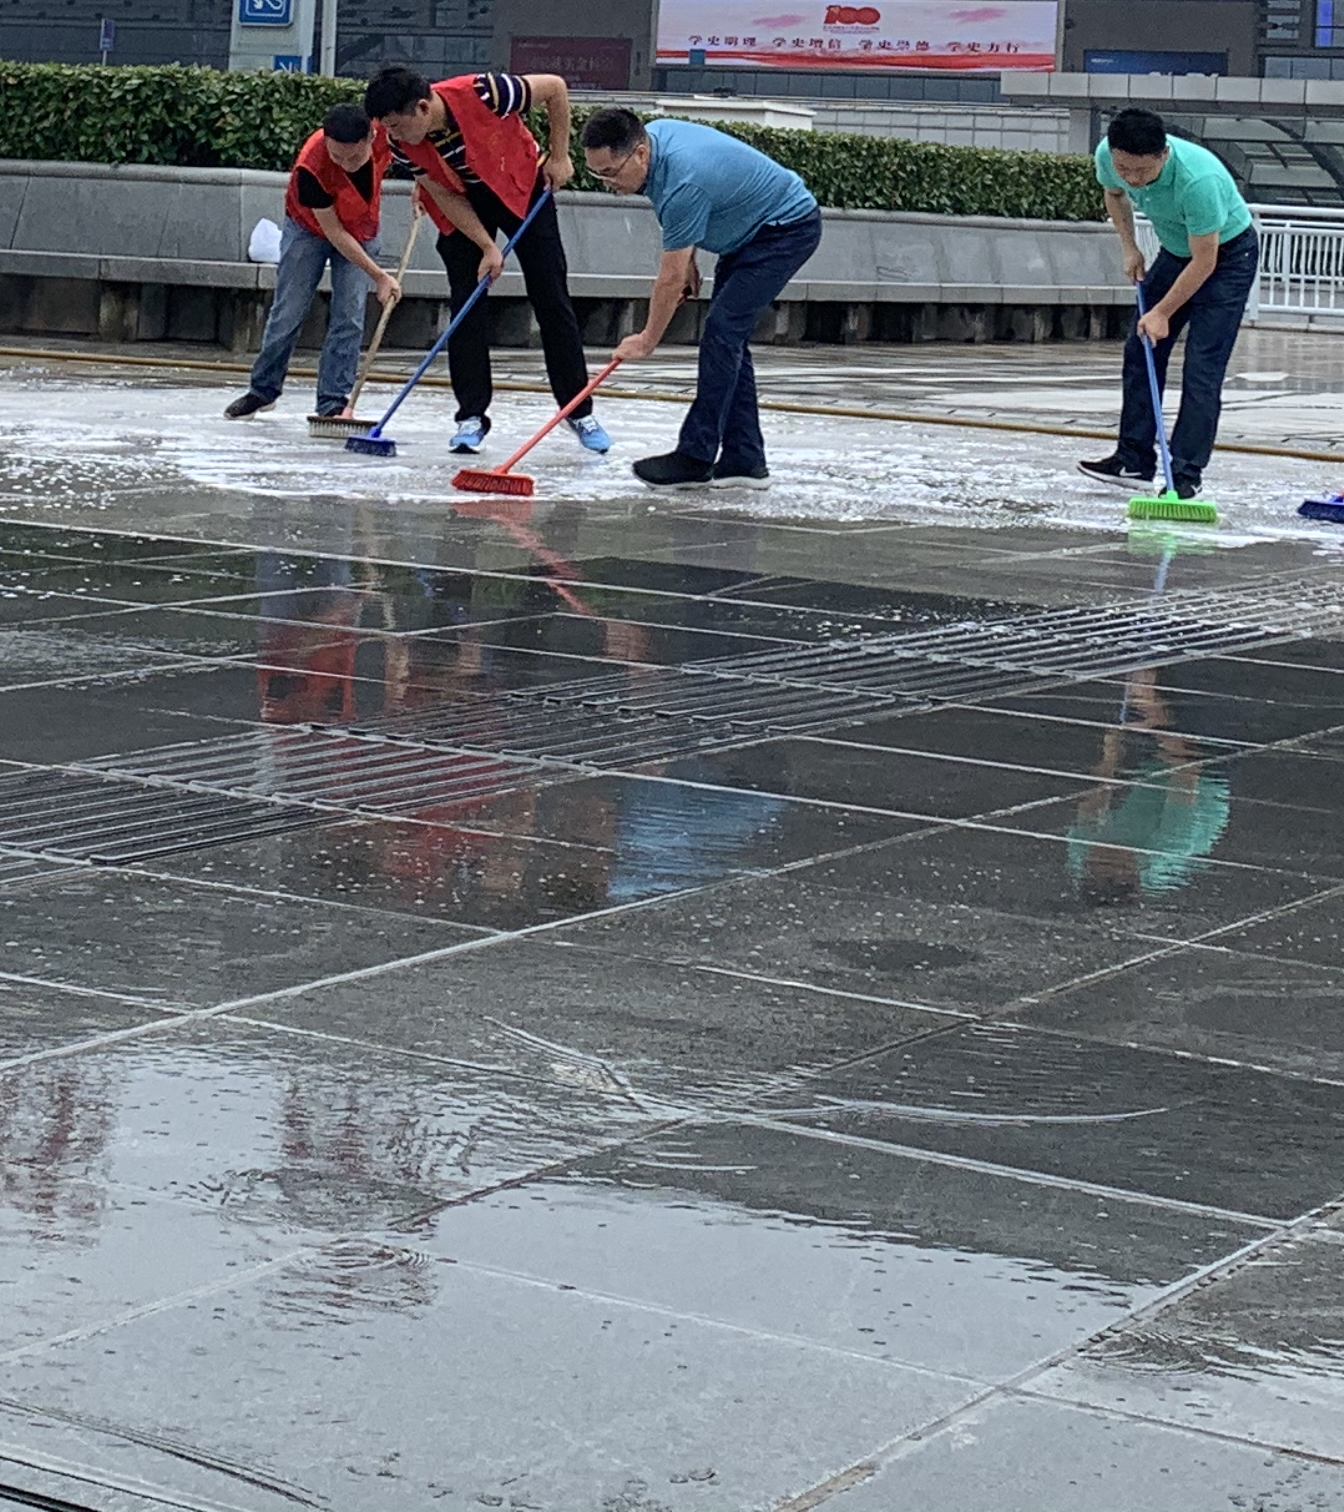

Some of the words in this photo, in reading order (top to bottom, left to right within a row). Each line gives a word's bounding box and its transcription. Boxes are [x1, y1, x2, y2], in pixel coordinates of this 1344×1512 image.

[824, 5, 881, 25] 100
[688, 35, 757, 47] 学史明理
